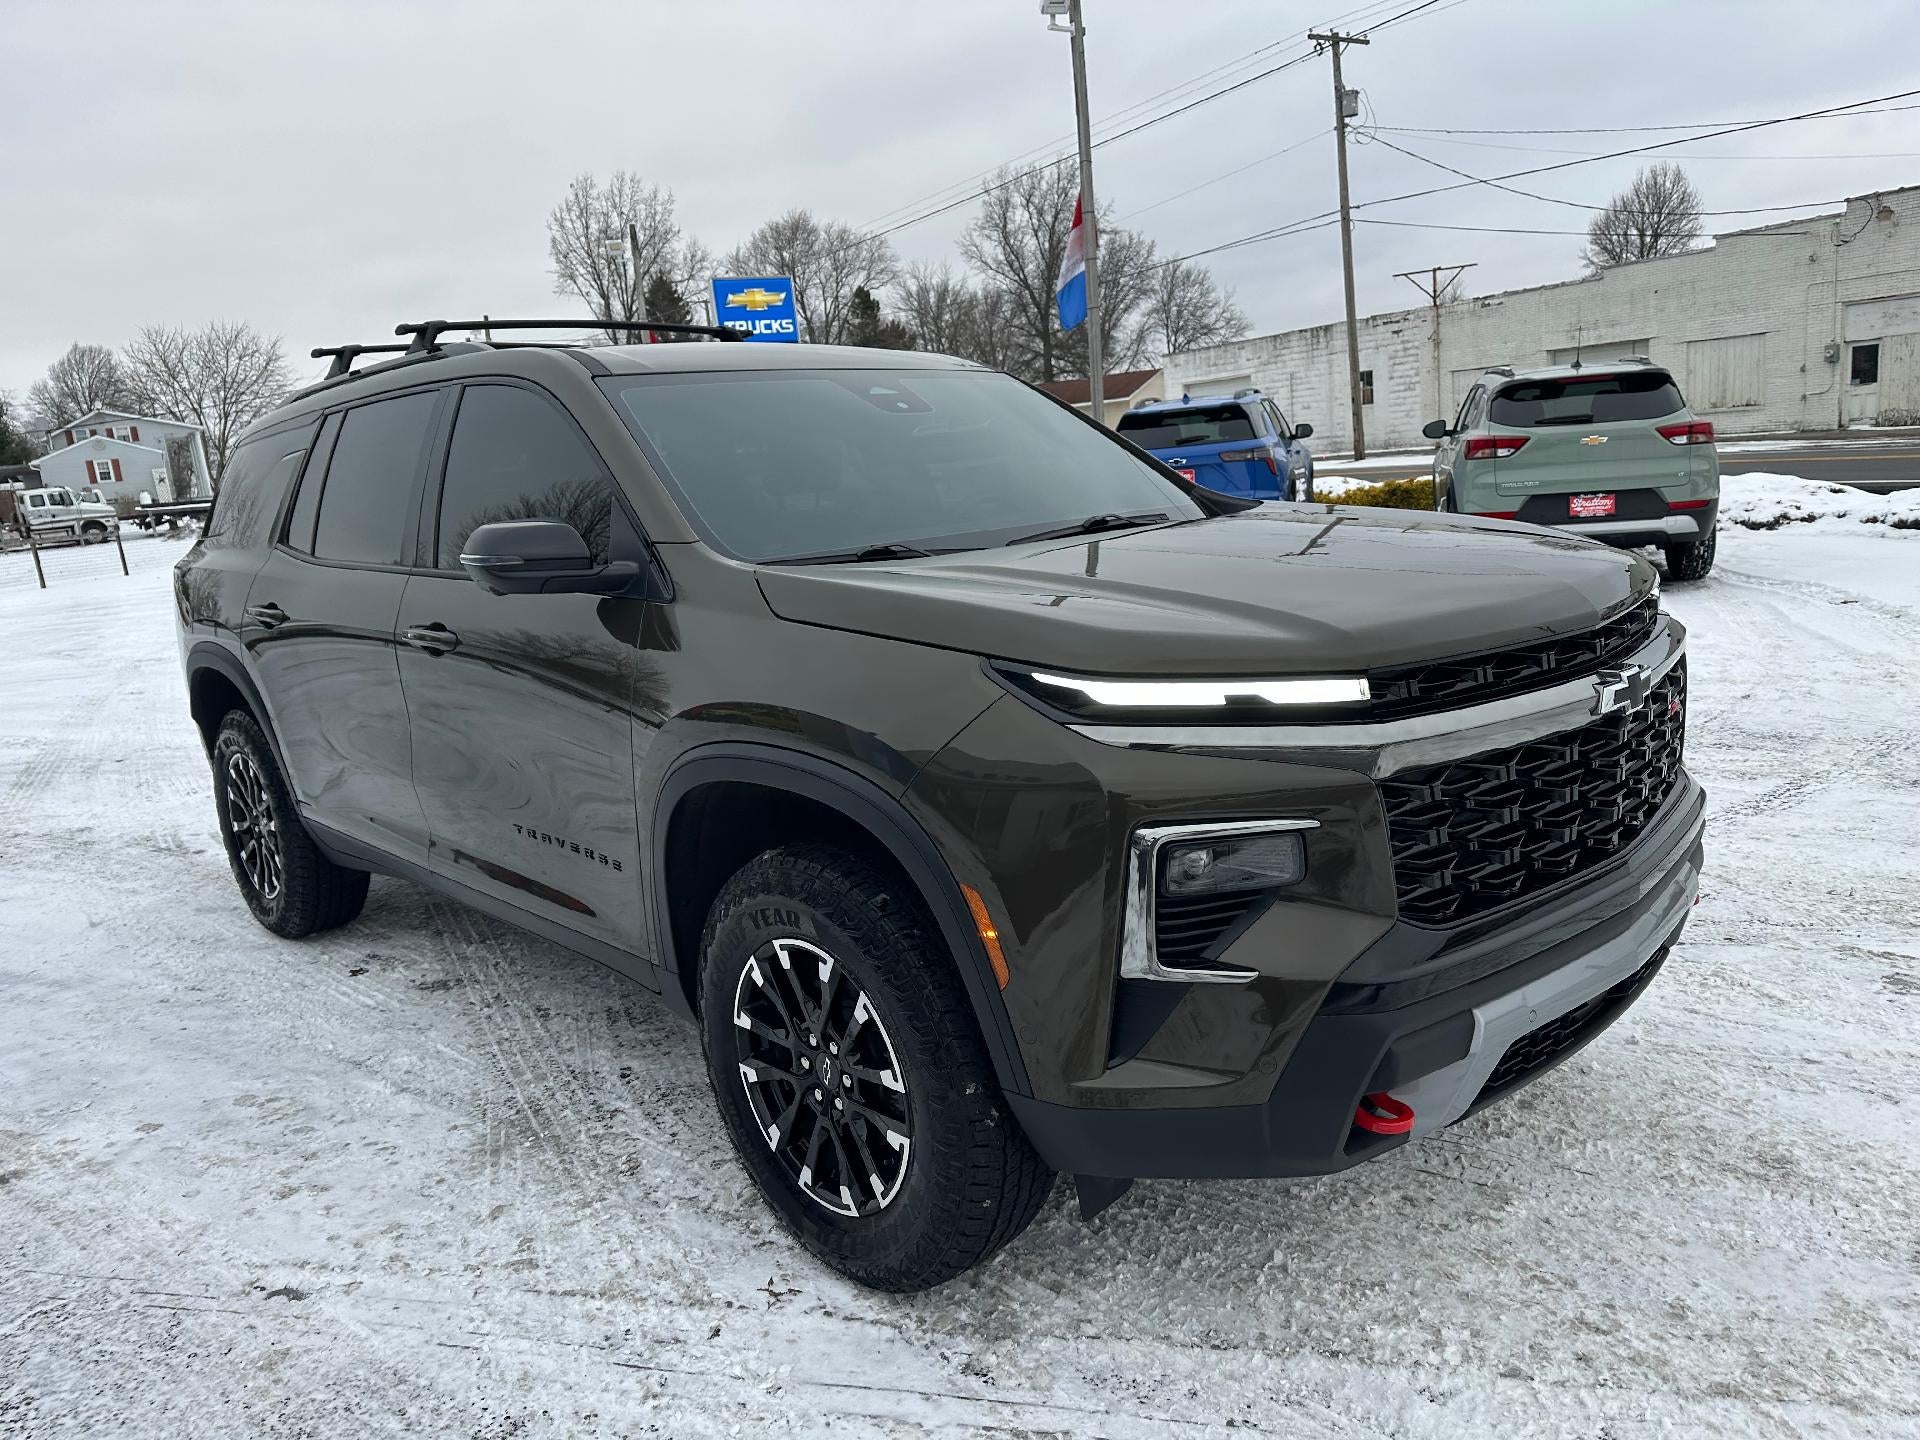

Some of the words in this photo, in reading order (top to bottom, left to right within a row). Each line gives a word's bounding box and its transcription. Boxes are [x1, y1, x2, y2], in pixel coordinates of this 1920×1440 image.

[1571, 497, 1613, 508] Stratton
[512, 823, 623, 872] TRAVERSE
[747, 907, 801, 930] YEAR
